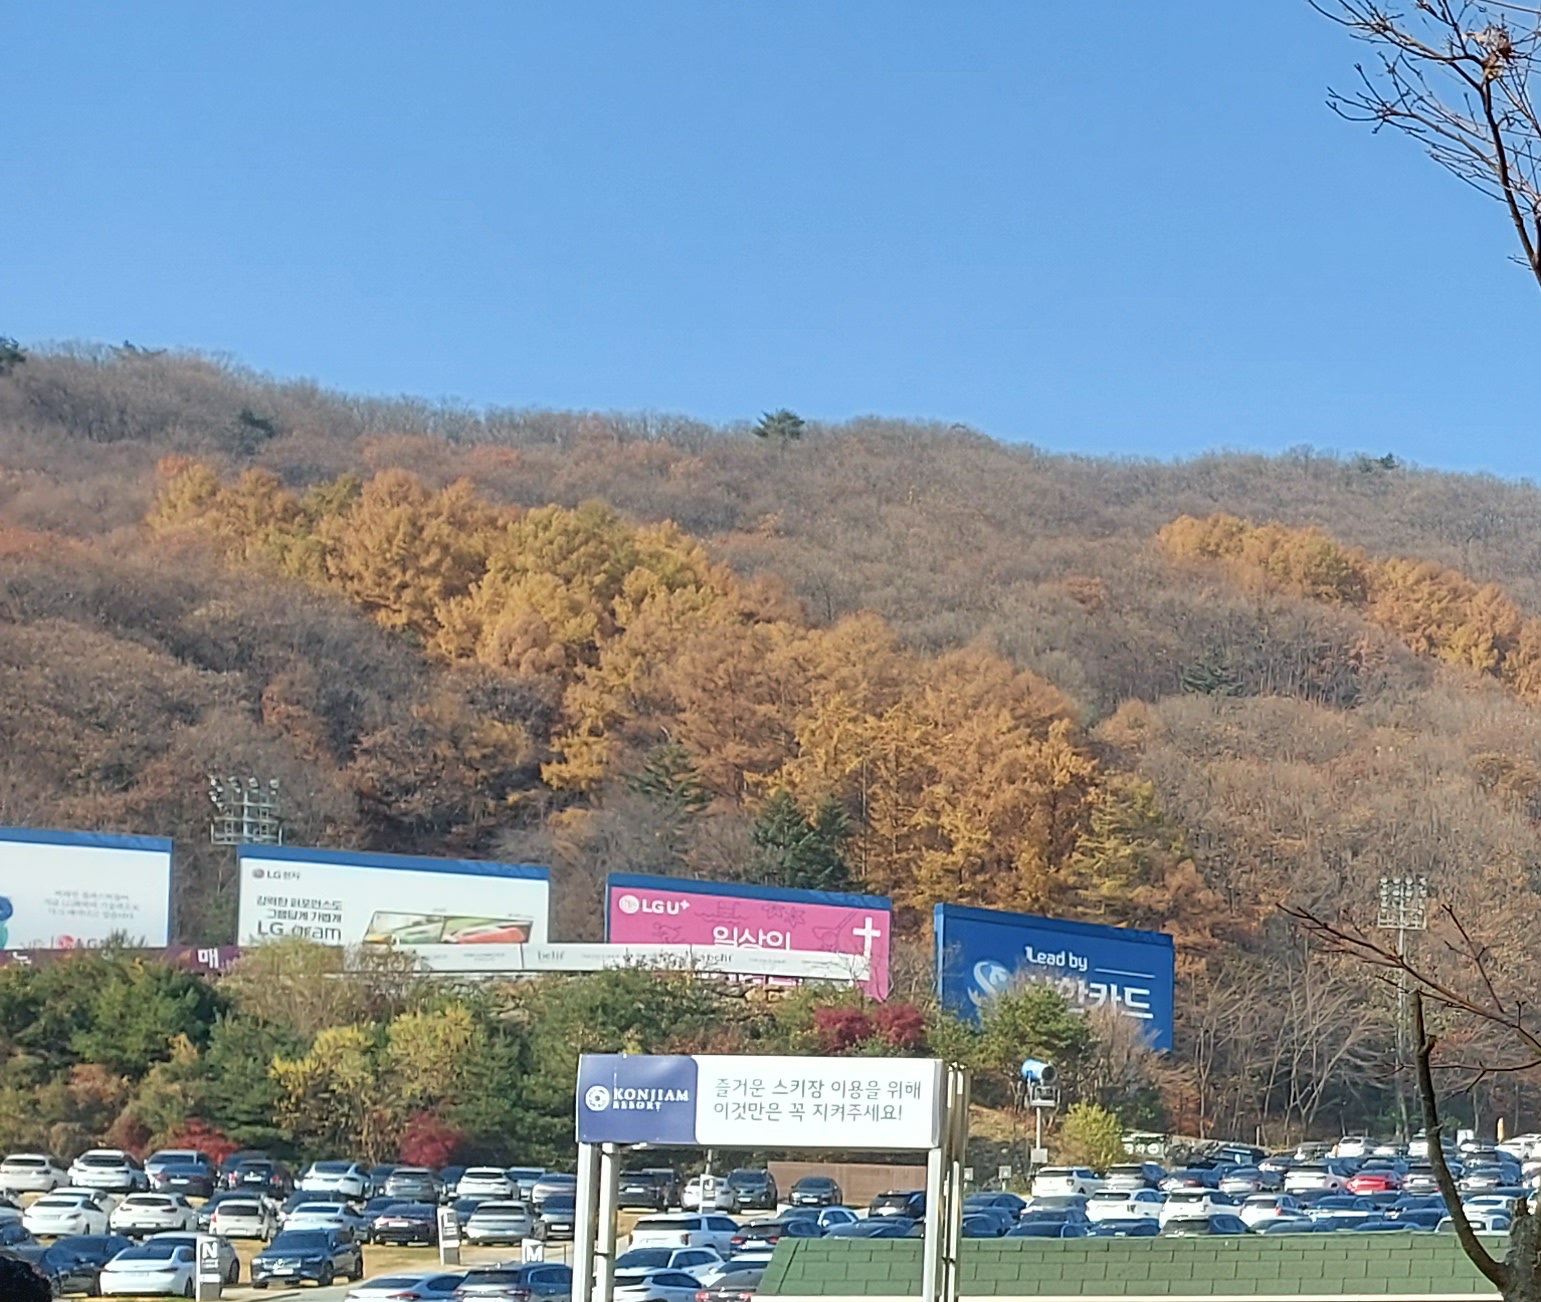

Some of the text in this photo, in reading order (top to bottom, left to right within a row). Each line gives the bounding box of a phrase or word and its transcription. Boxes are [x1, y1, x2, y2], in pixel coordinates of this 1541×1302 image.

[257, 920, 284, 936] LG
[1025, 946, 1088, 971] Lead by
[613, 1087, 690, 1102] KONJIAM
[714, 1078, 922, 1100] 즐거운 스키장 이용을 위해
[714, 1101, 903, 1123] 이것만은 꼭 지켜주세요!
[202, 1242, 218, 1258] N
[526, 1245, 543, 1262] M
